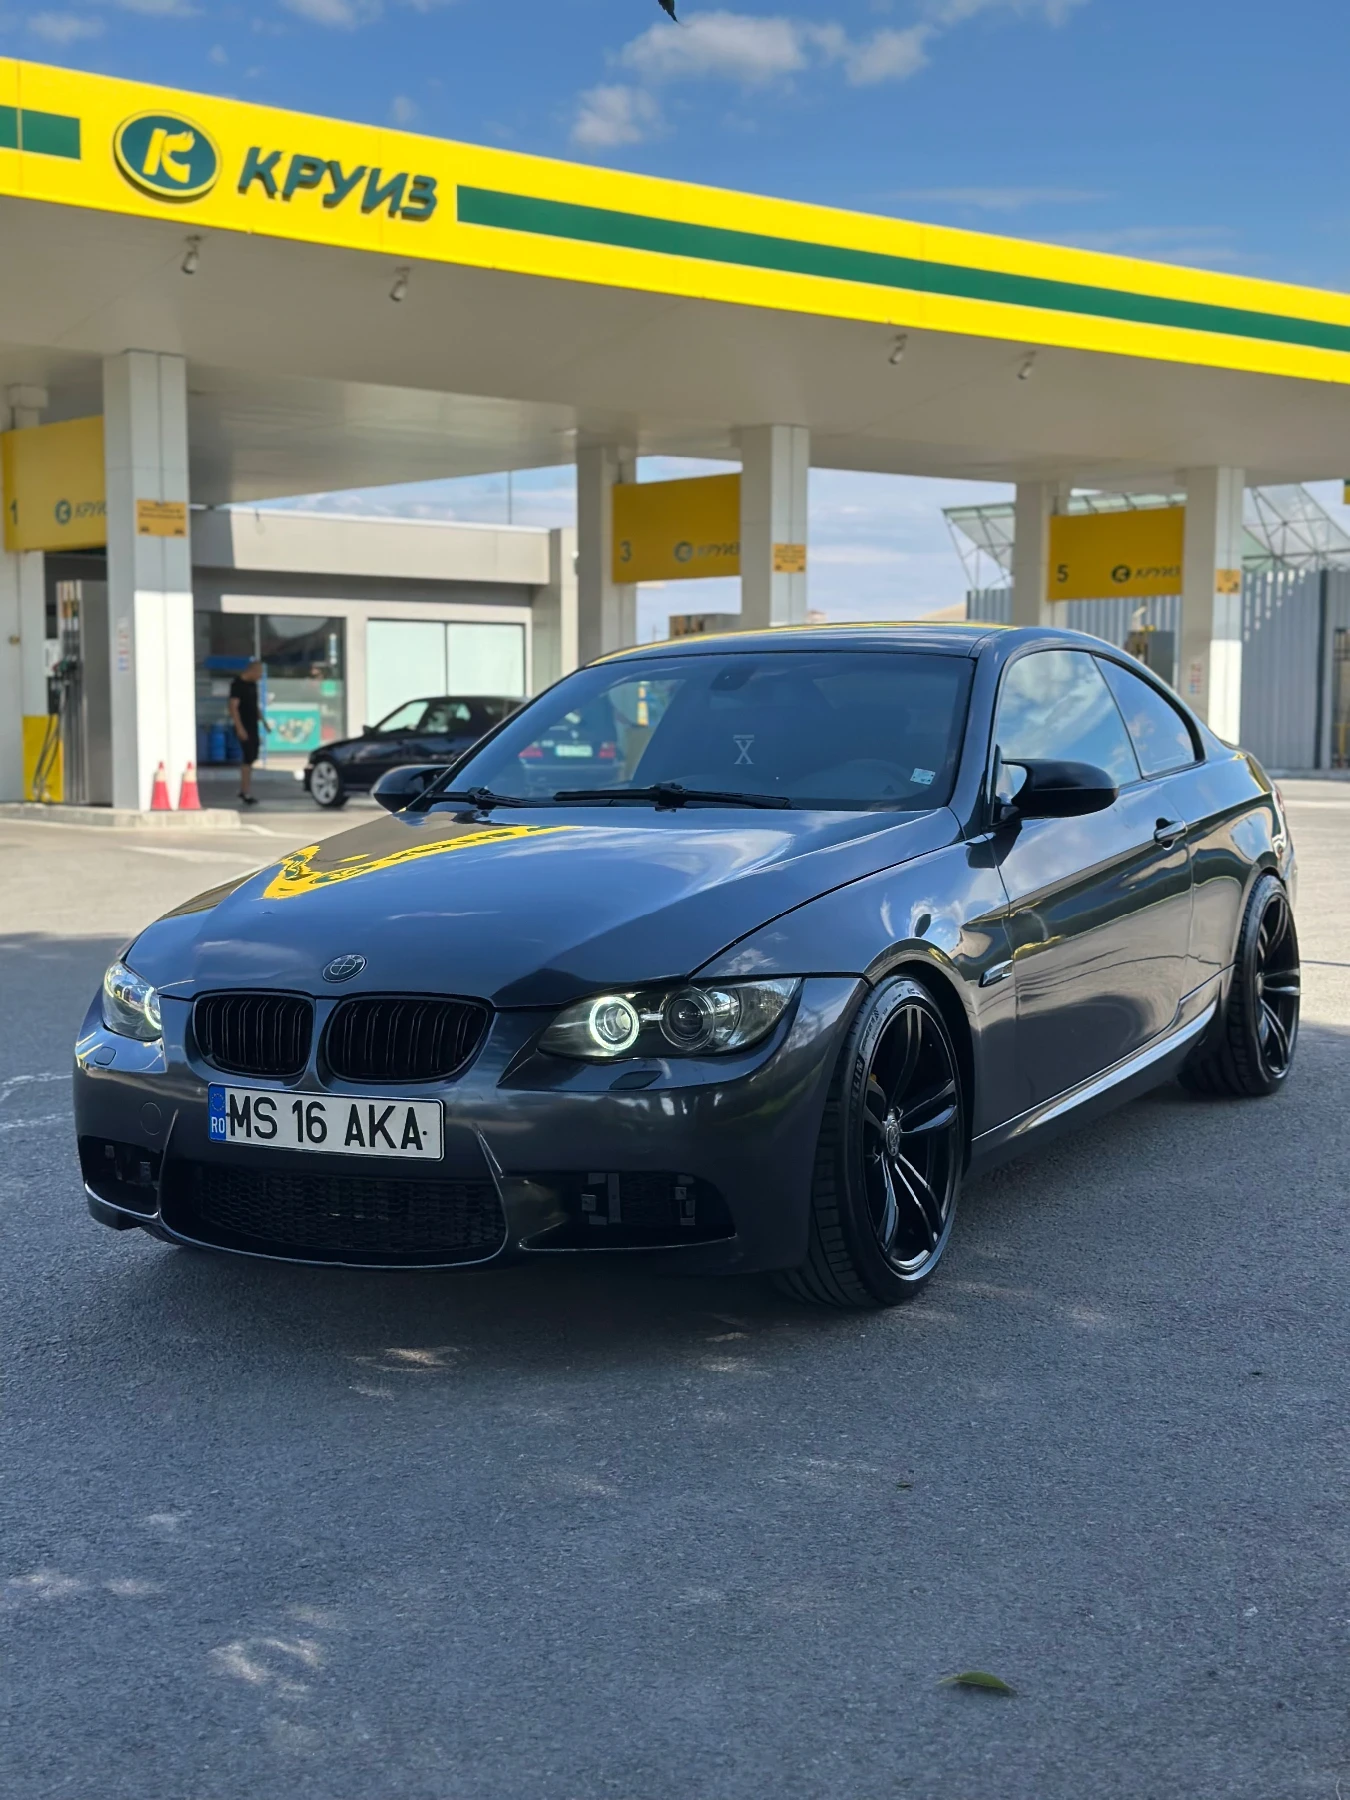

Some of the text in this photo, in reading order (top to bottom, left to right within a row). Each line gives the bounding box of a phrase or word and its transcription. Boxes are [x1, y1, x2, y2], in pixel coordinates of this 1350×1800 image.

[238, 146, 438, 222] КРУИЗ
[10, 498, 18, 526] 1
[620, 540, 632, 562] 3
[1057, 564, 1068, 583] 5
[211, 1116, 225, 1134] RO
[229, 1093, 423, 1151] MS 16 AKA
